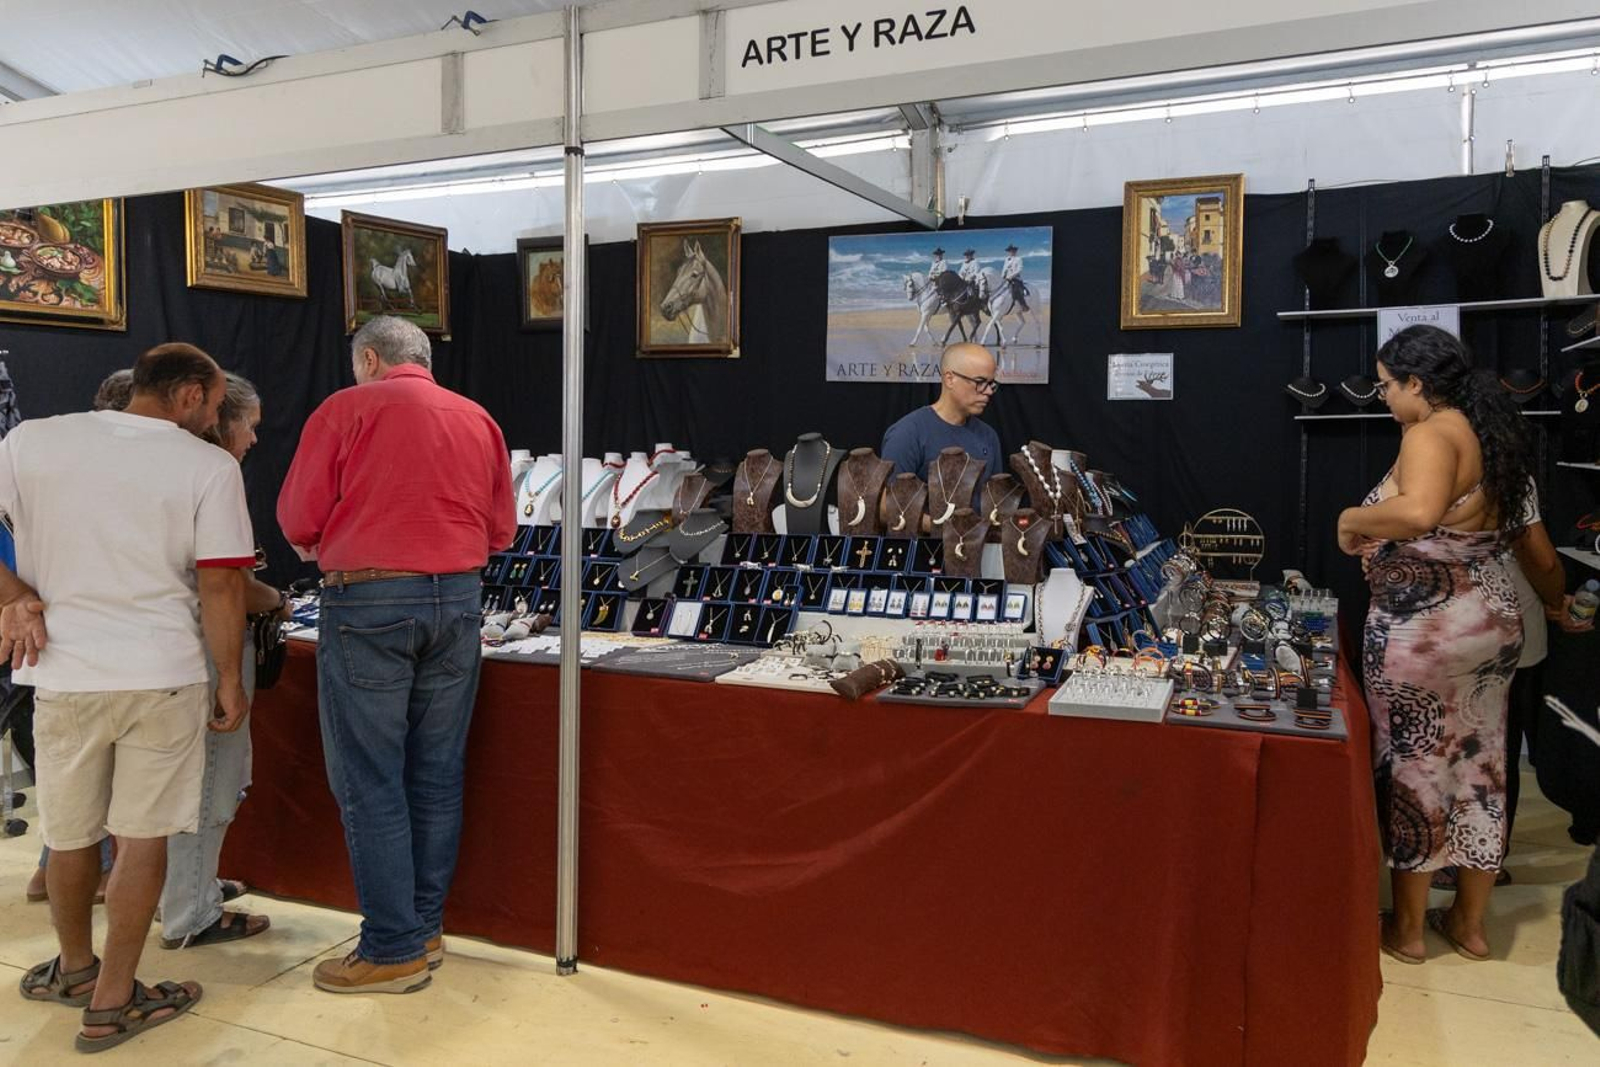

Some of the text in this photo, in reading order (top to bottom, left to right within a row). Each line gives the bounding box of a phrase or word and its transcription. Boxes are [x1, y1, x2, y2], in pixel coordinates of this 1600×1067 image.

[741, 5, 976, 68] ARTE Y RAZA
[1397, 310, 1440, 322] Venta al
[836, 363, 877, 377] ARTE
[898, 363, 941, 377] RAZA
